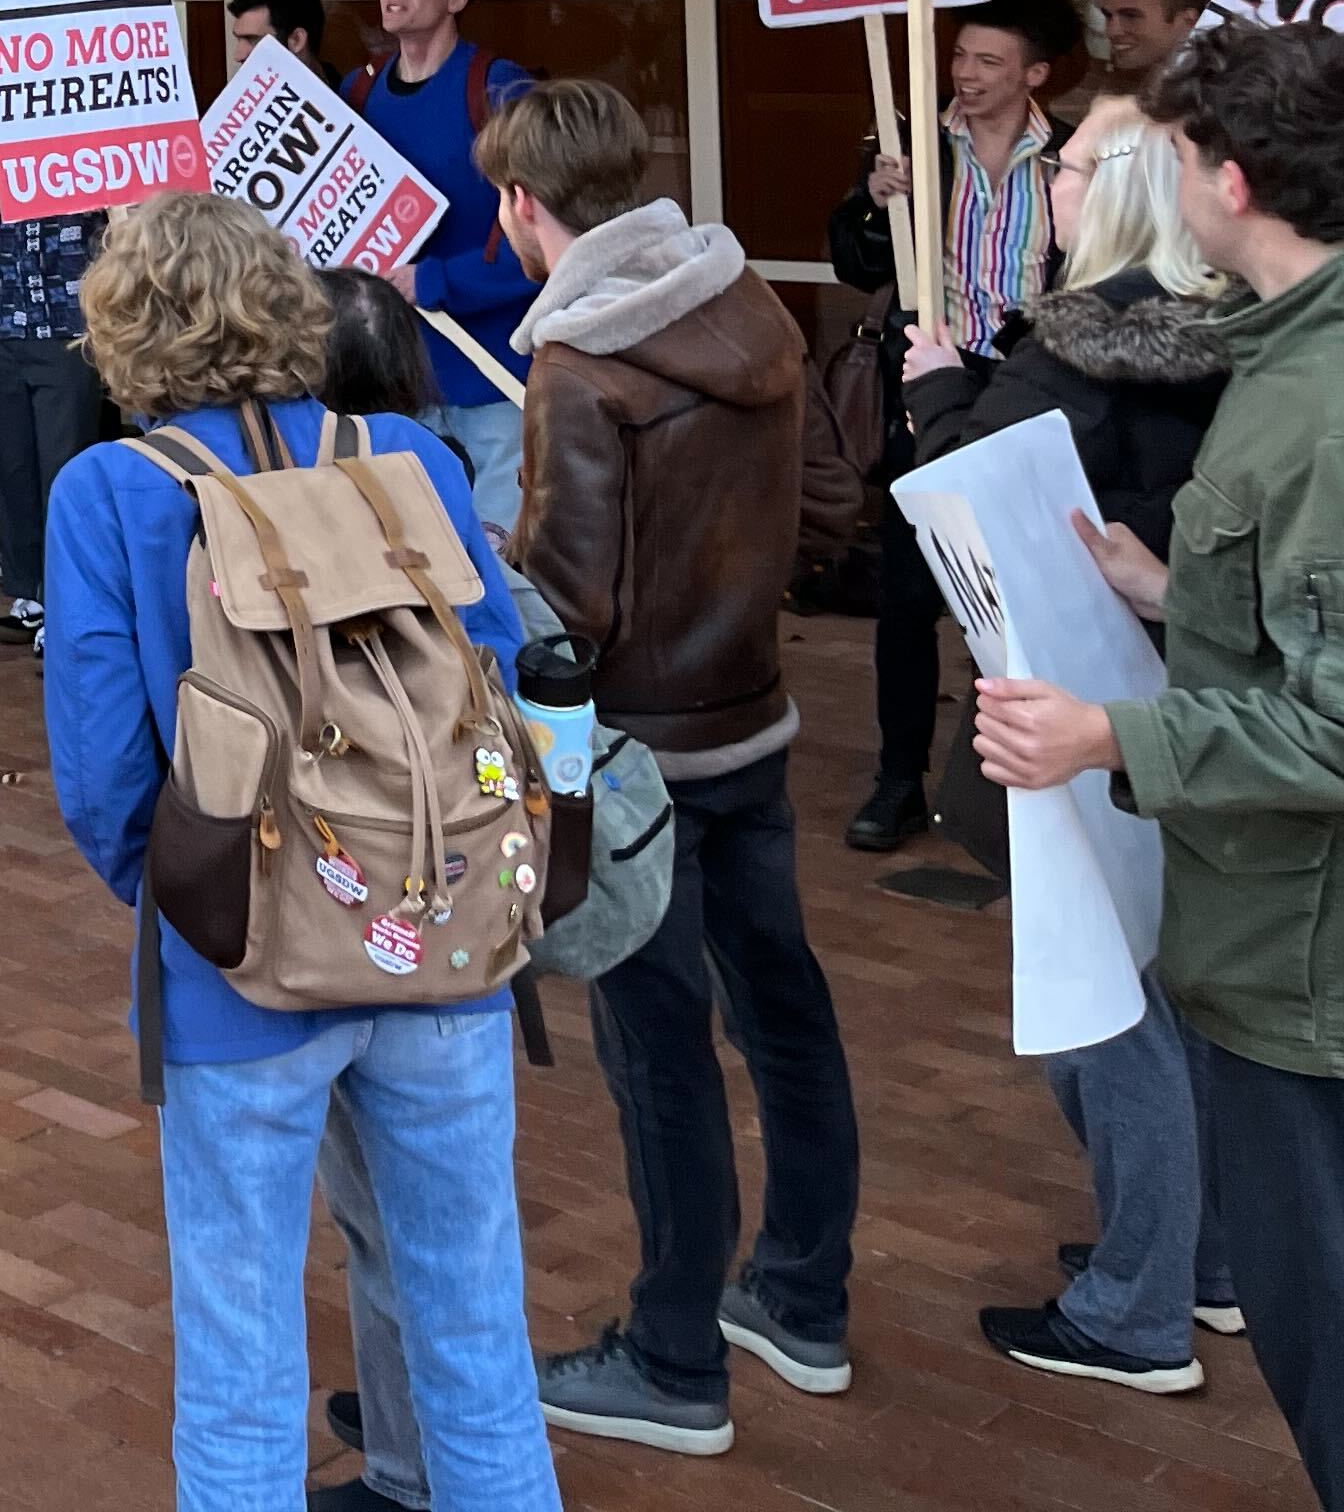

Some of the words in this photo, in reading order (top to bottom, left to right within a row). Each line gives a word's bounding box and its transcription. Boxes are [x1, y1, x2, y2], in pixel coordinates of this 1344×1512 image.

[65, 21, 169, 68] MORE
[208, 67, 279, 172] INNELL:
[213, 82, 300, 196] ARGAIN
[247, 100, 335, 211] OW!
[2, 140, 169, 204] UGSDW
[297, 144, 366, 241] MORE
[305, 163, 385, 265] REATS!
[372, 931, 393, 951] We
[394, 943, 417, 961] Do
